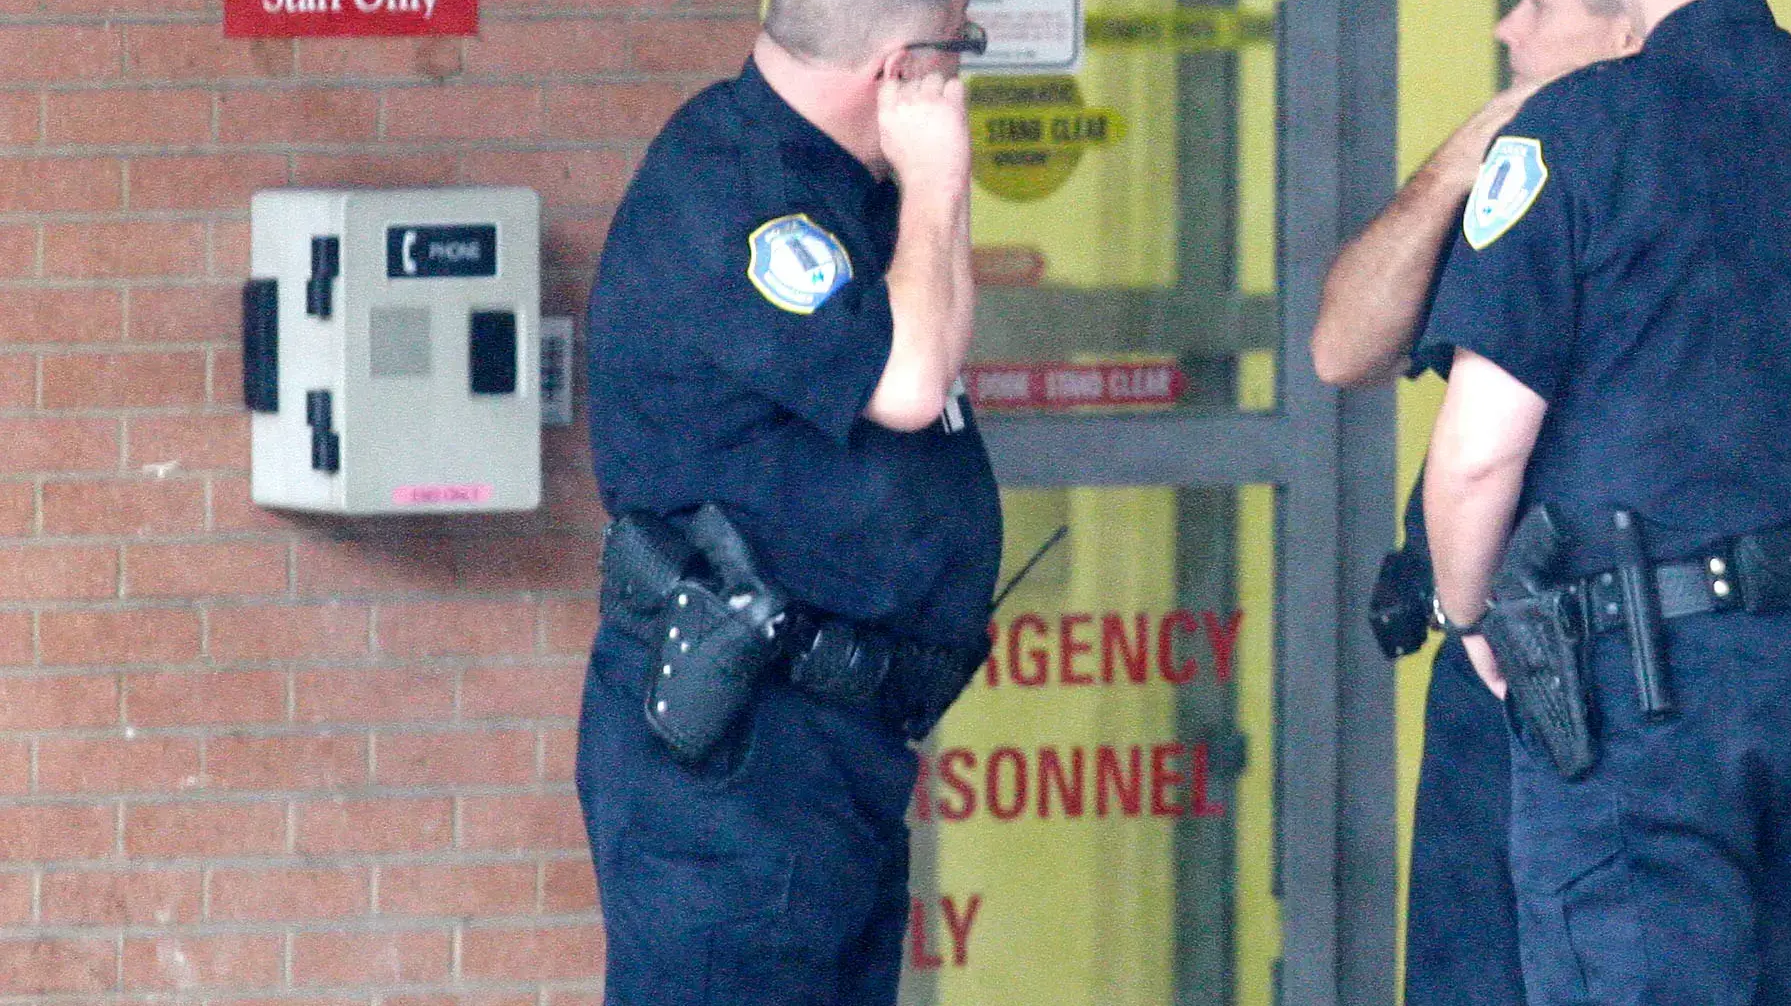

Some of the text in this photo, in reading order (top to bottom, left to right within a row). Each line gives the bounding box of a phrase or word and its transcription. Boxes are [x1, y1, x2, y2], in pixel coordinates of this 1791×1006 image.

[986, 115, 1108, 142] STAND CLEAR
[428, 241, 481, 261] PHONE
[1108, 367, 1169, 396] CLEAR
